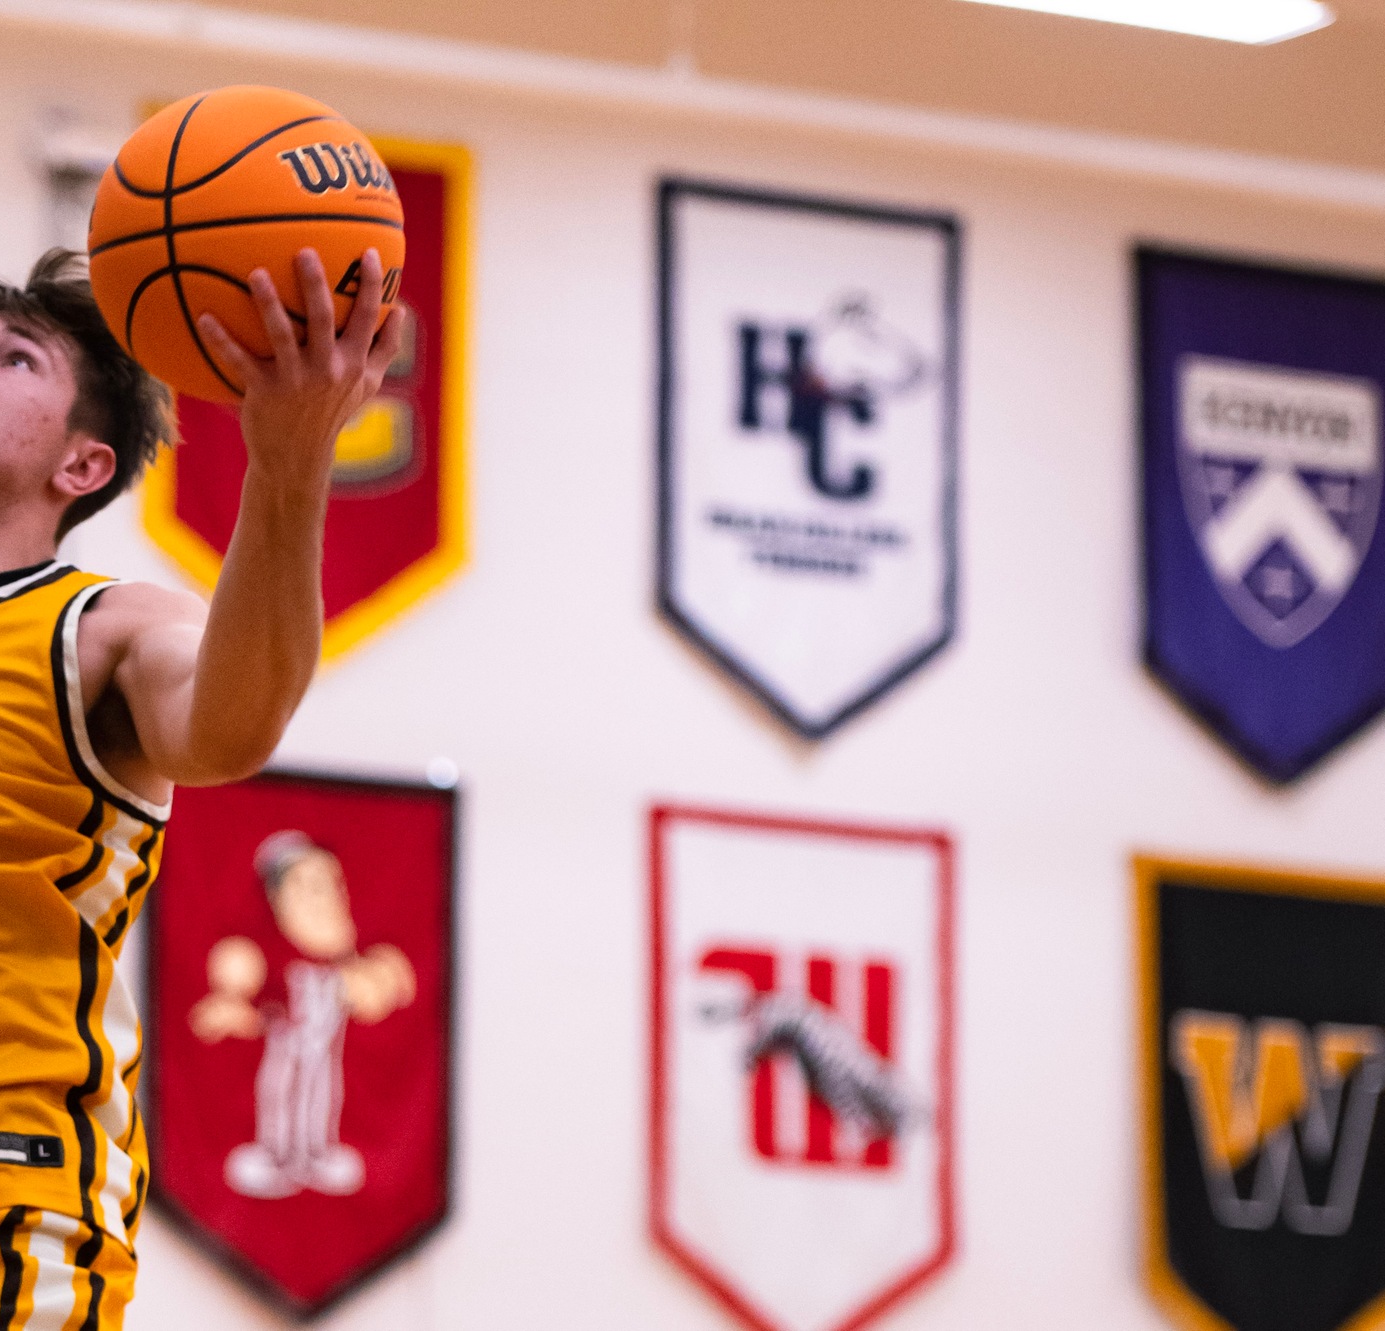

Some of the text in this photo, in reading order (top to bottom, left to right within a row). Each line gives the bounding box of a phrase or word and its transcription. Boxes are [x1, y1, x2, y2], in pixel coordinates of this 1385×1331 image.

[736, 320, 876, 500] HC
[37, 1143, 51, 1158] L
[1172, 1008, 1385, 1236] W
